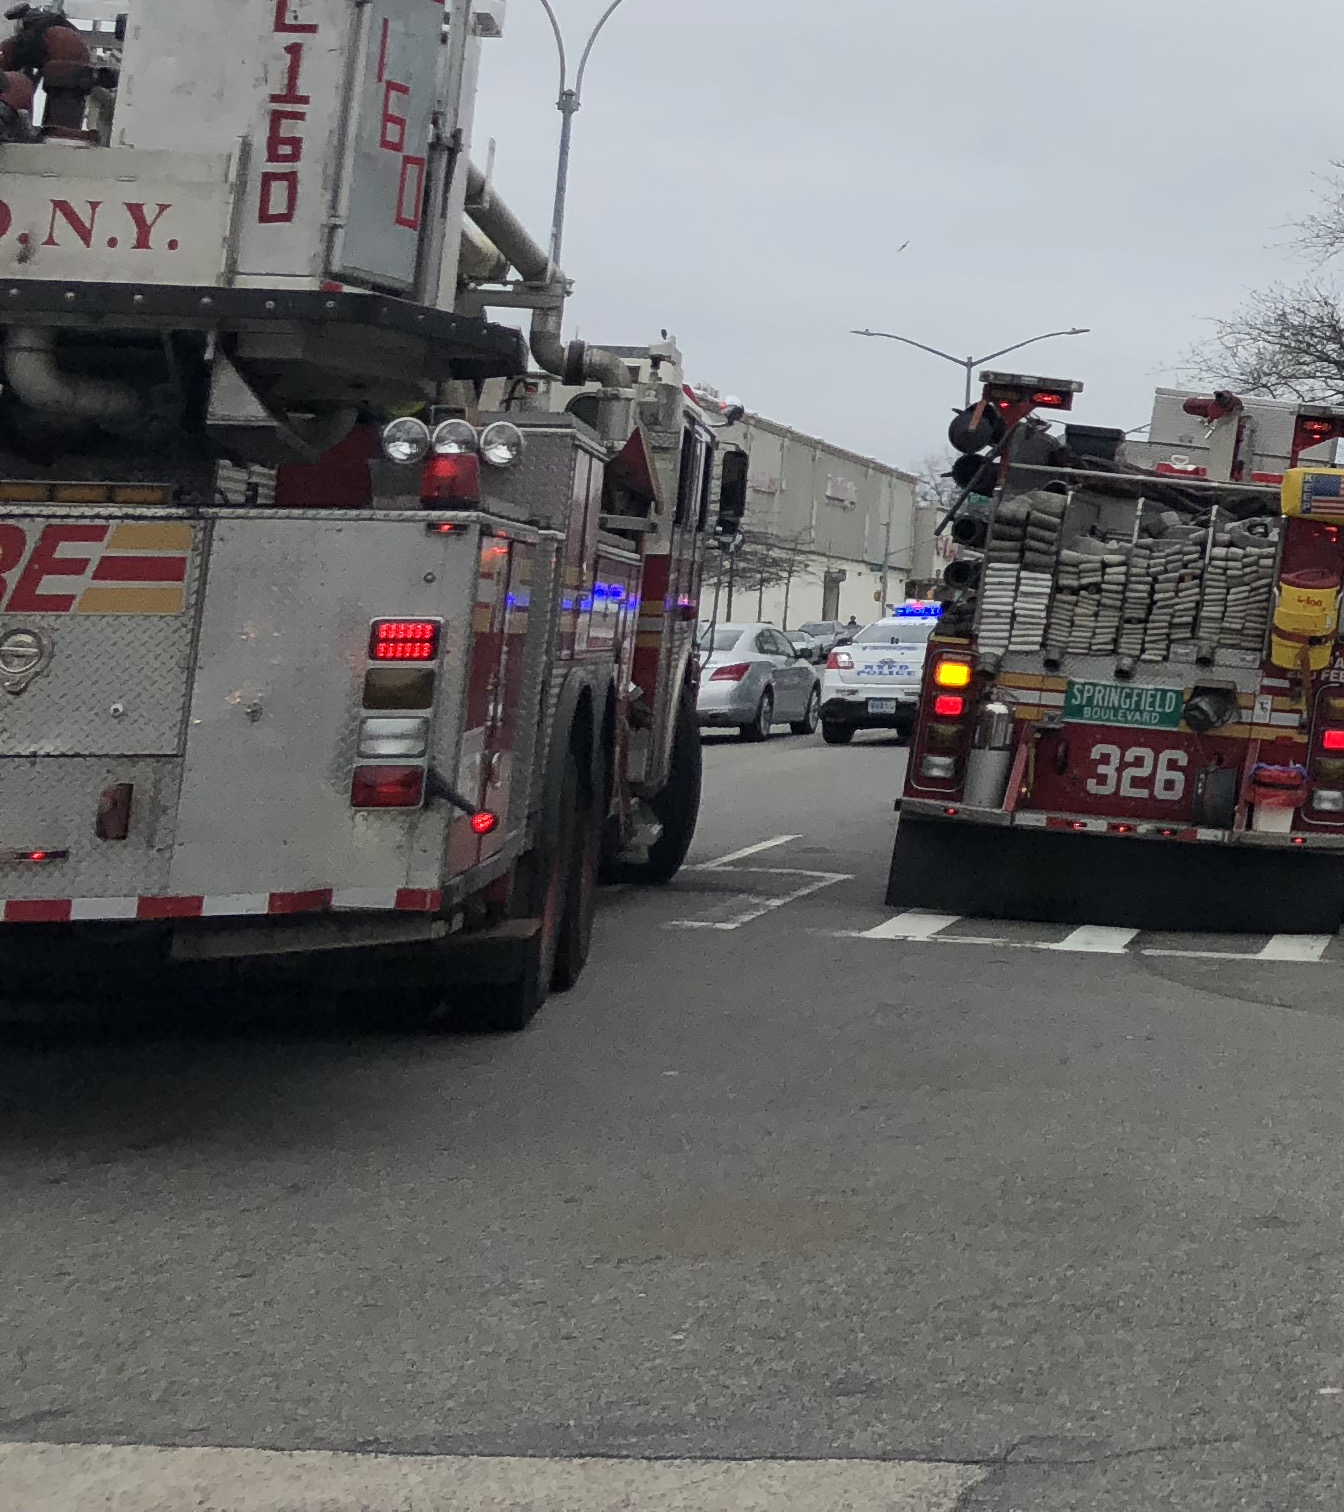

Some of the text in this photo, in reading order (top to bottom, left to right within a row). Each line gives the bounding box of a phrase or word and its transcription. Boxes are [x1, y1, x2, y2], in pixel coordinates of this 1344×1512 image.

[377, 15, 426, 231] 160
[0, 199, 179, 251] .N.Y.
[1302, 474, 1314, 510] KEEP
[1072, 684, 1177, 713] SPRINGFIELD
[1083, 706, 1160, 724] BOULEVARD
[1087, 743, 1189, 801] 326
